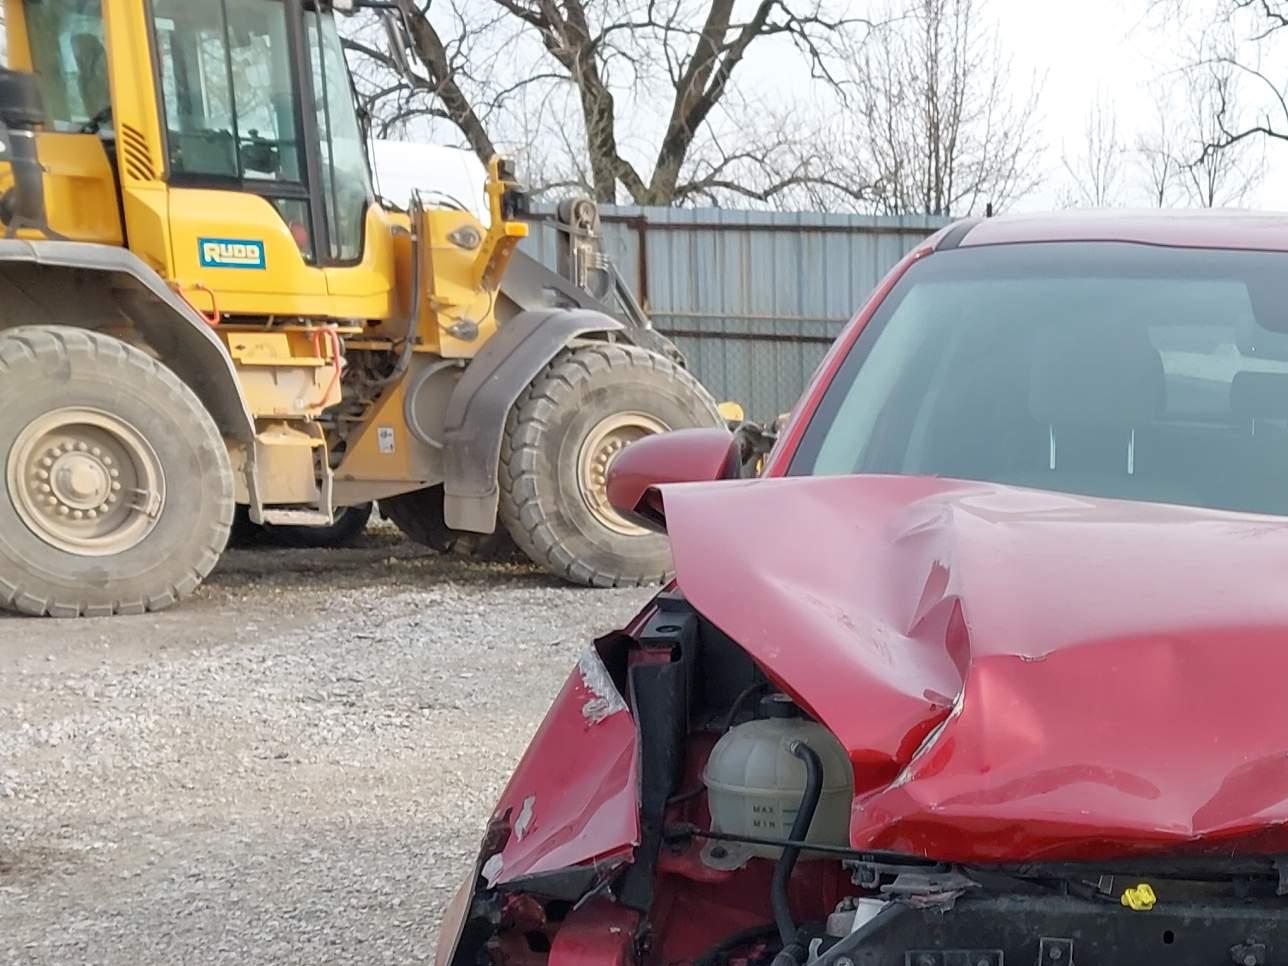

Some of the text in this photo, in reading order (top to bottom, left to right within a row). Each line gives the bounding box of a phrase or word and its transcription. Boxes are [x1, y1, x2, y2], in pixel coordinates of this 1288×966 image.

[203, 242, 261, 264] RUDD
[752, 804, 775, 814] MAX
[752, 819, 776, 829] MIN
